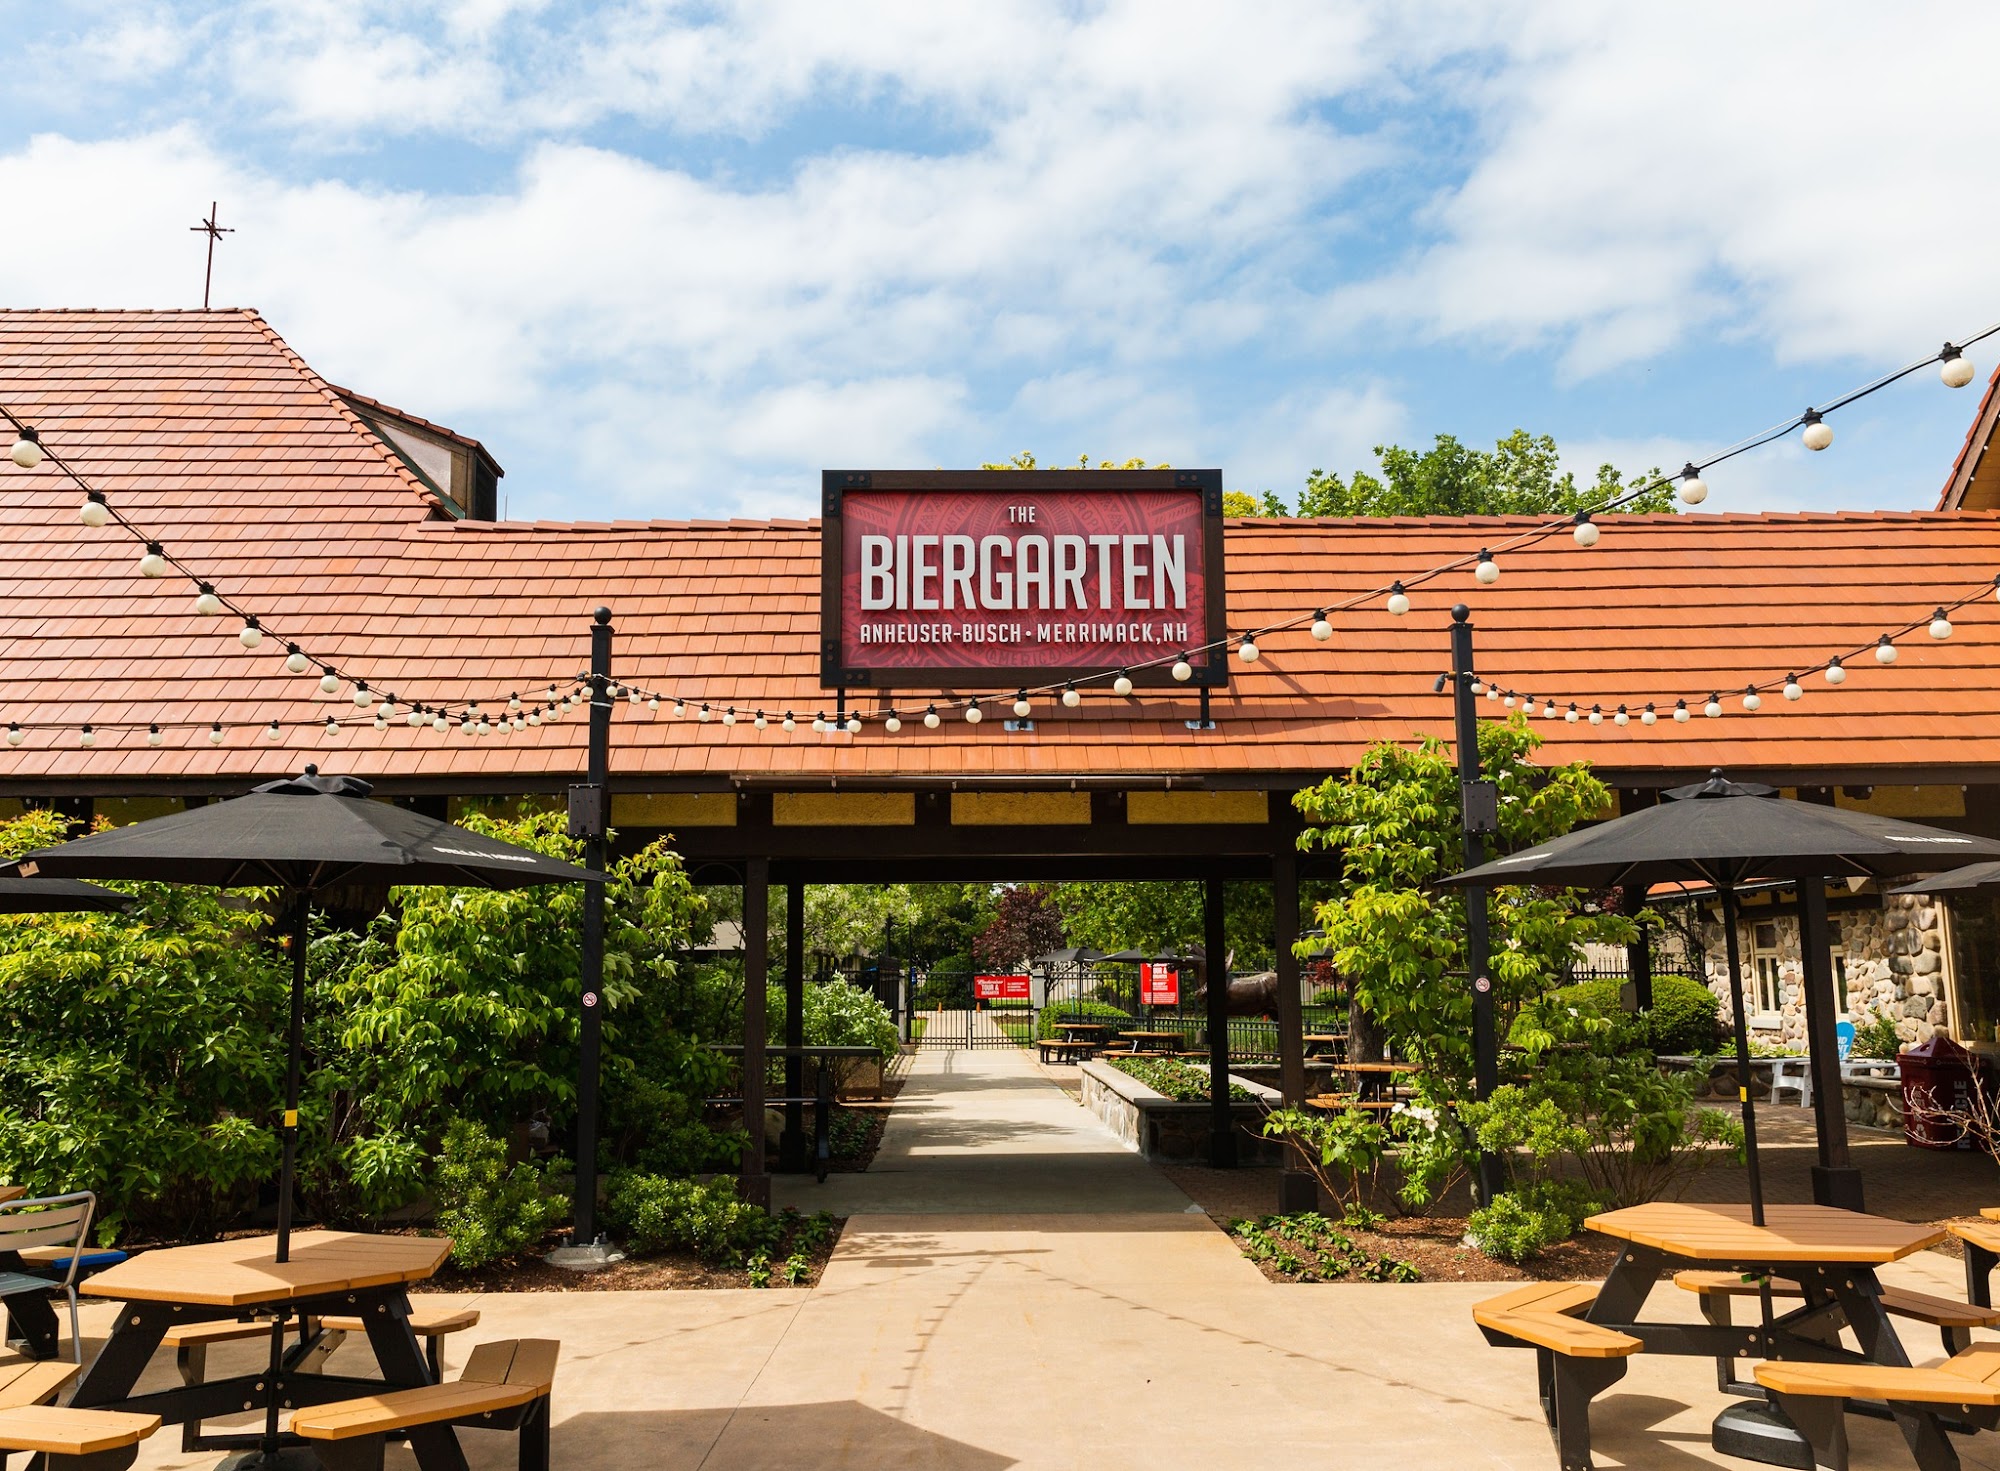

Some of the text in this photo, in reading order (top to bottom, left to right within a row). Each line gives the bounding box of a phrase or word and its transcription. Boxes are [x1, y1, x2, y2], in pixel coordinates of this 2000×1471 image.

[1008, 506, 1036, 523] THE
[860, 534, 1187, 610] BIERGARTEN
[860, 623, 1021, 643] ANHEUSER-BUSCH
